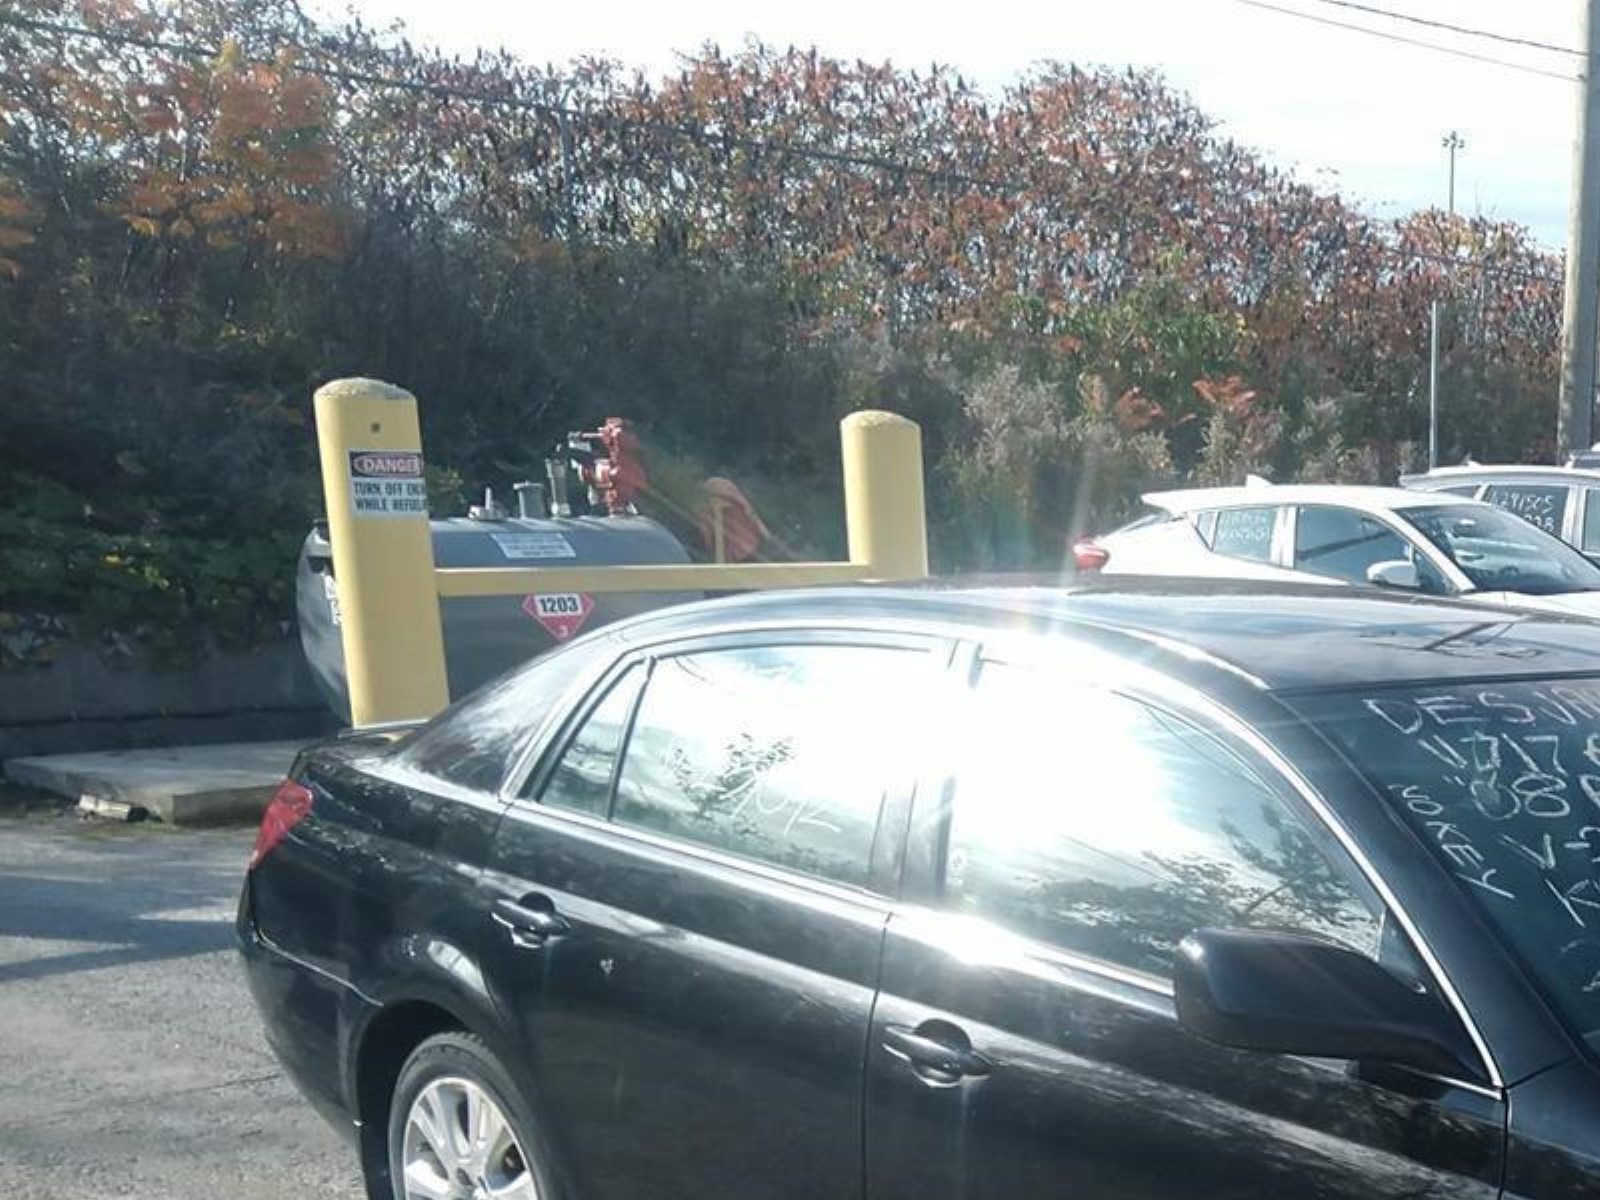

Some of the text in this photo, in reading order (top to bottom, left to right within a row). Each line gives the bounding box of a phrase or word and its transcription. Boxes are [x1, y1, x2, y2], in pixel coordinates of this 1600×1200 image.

[354, 482, 380, 496] TURN
[385, 482, 402, 496] OFF
[356, 498, 386, 512] WHILE
[540, 596, 579, 613] 1203
